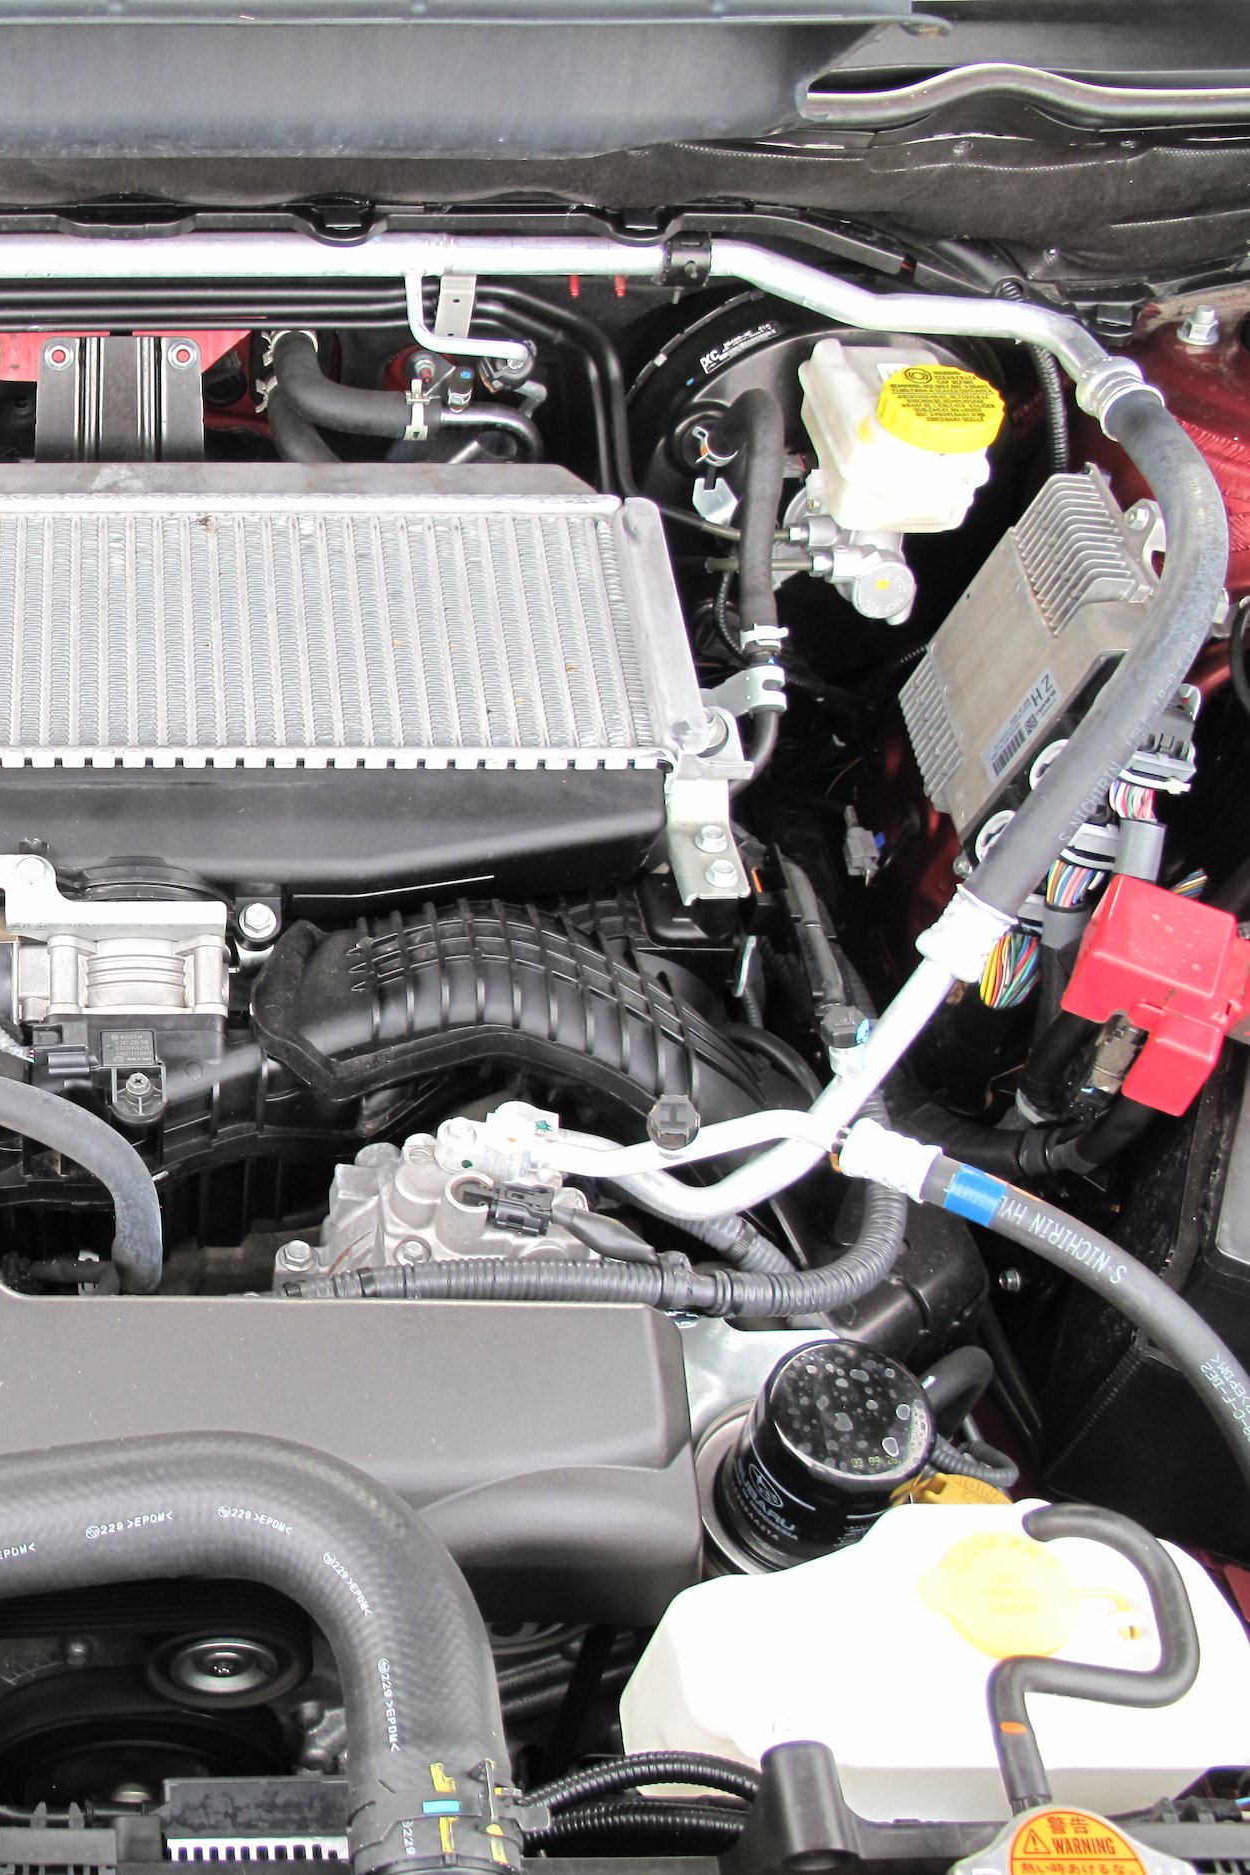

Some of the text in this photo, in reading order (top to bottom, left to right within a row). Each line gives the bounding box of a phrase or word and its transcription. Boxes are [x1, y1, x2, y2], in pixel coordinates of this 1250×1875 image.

[230, 1507, 252, 1520] 229
[100, 1521, 124, 1535] 229
[331, 1560, 349, 1580] 229
[380, 1672, 393, 1698] 229
[1047, 1815, 1089, 1835] 警告
[402, 1826, 416, 1856] 229
[1051, 1837, 1116, 1856] WARNING
